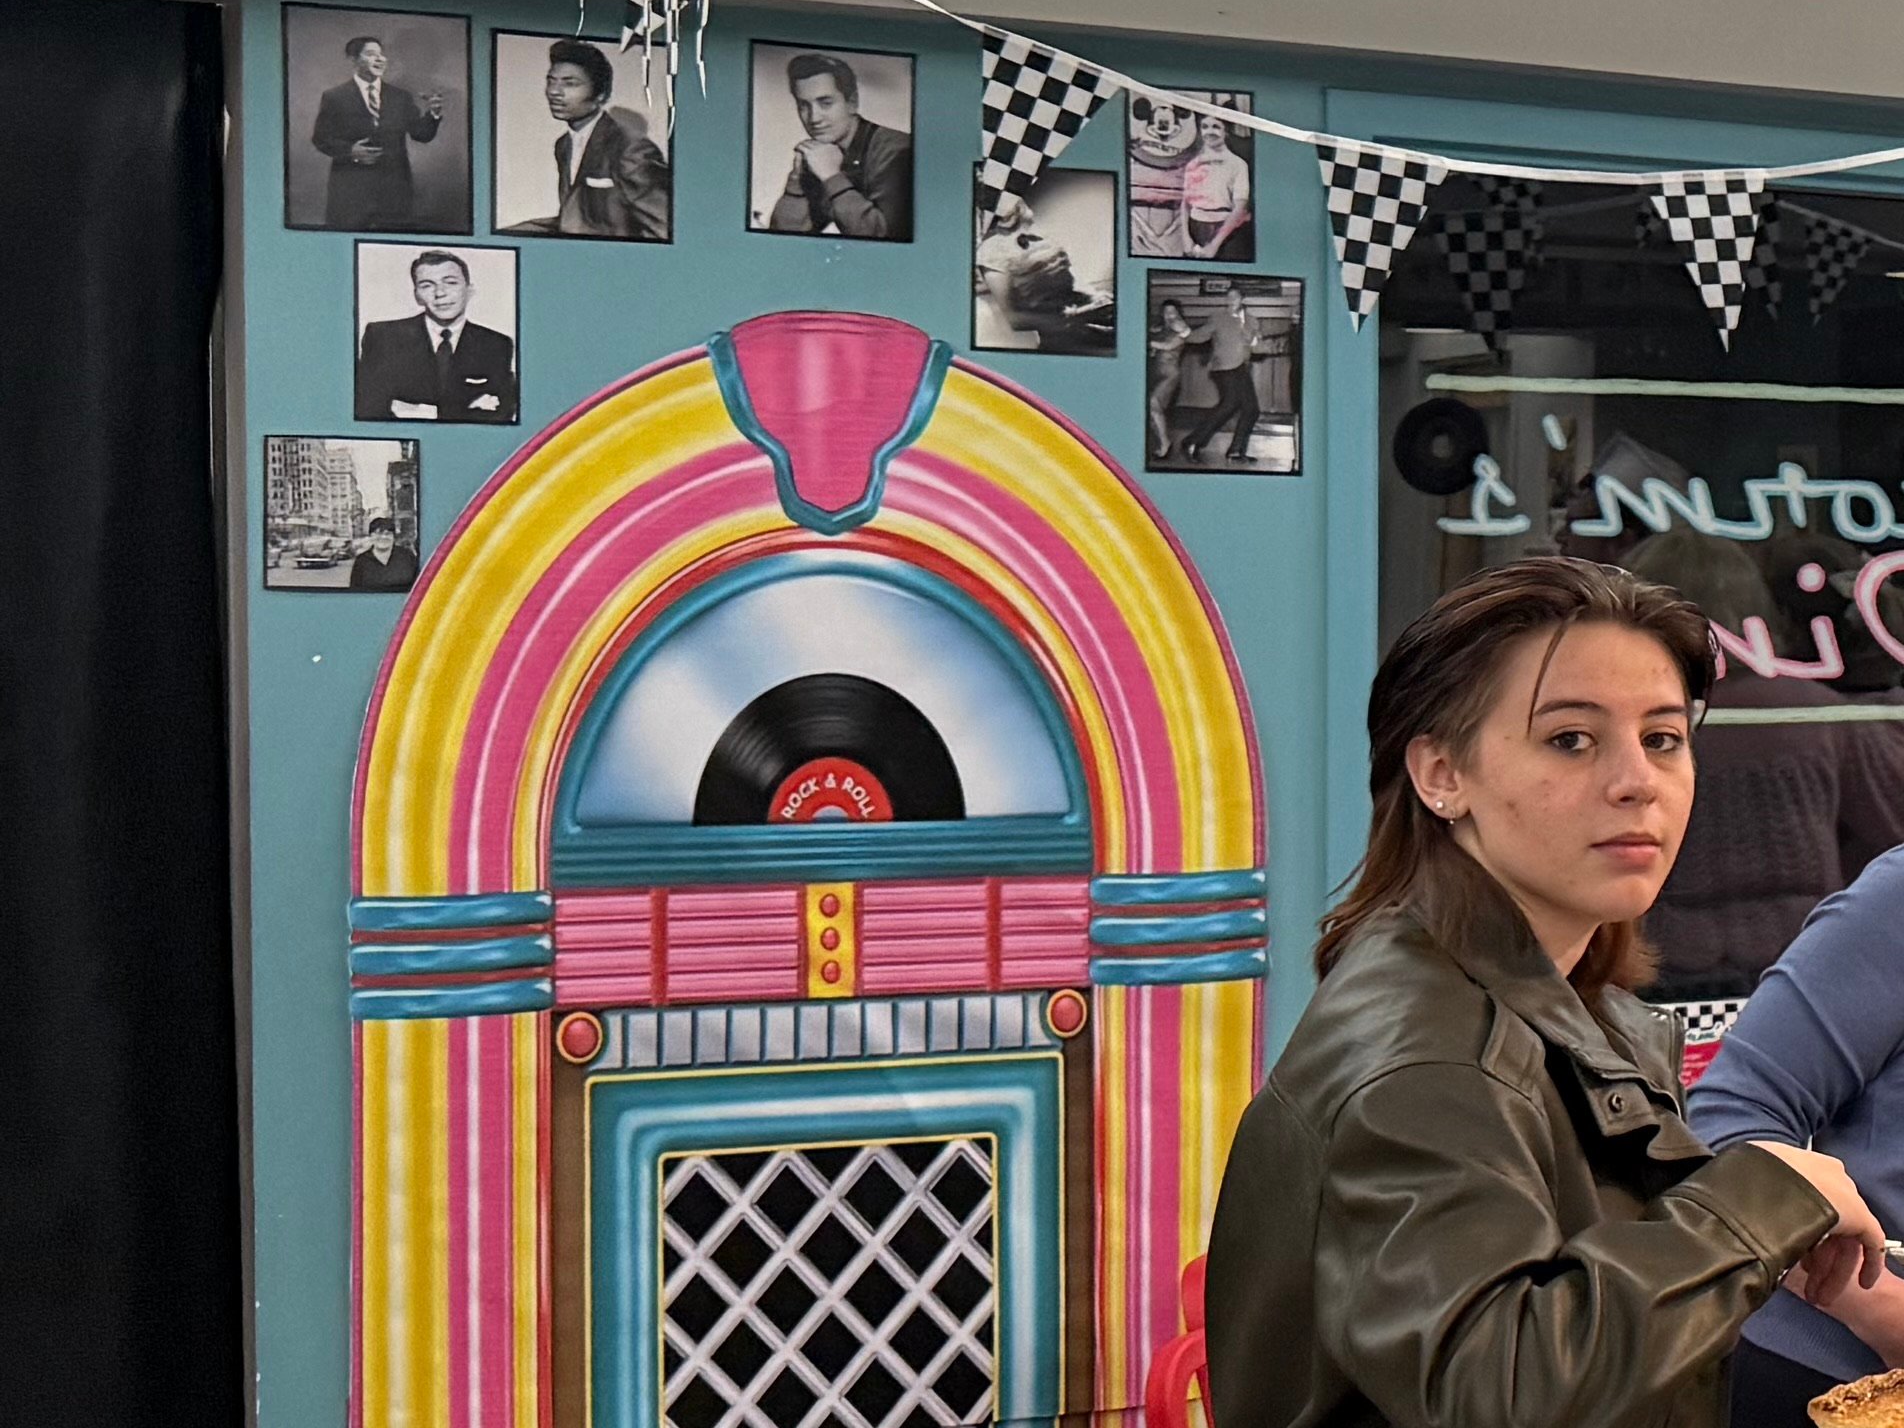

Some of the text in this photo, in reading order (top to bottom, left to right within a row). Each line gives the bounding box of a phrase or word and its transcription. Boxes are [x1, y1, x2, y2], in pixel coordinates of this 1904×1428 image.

[781, 772, 876, 819] ROCK & ROLL
